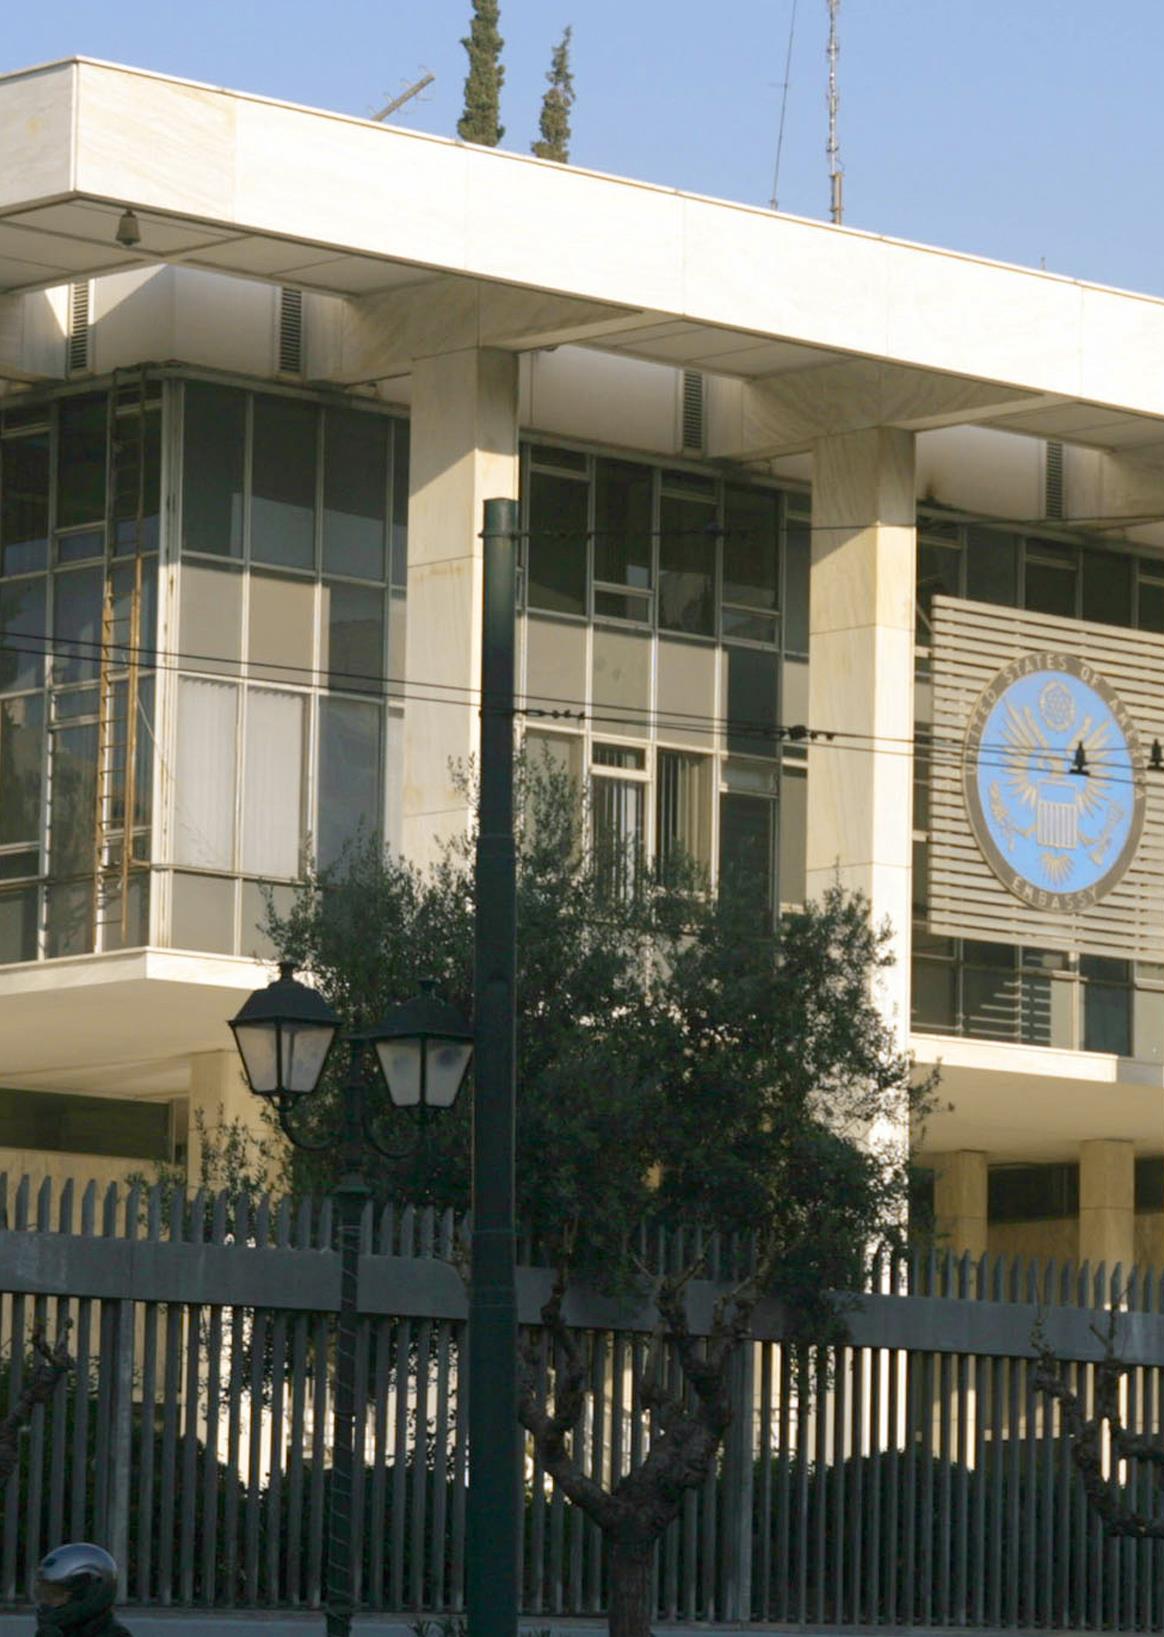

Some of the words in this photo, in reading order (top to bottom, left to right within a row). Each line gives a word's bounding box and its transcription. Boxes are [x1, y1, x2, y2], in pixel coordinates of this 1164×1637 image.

[1003, 654, 1067, 684] STATES
[1080, 666, 1101, 687] OF
[1012, 875, 1097, 911] EMBASSY
